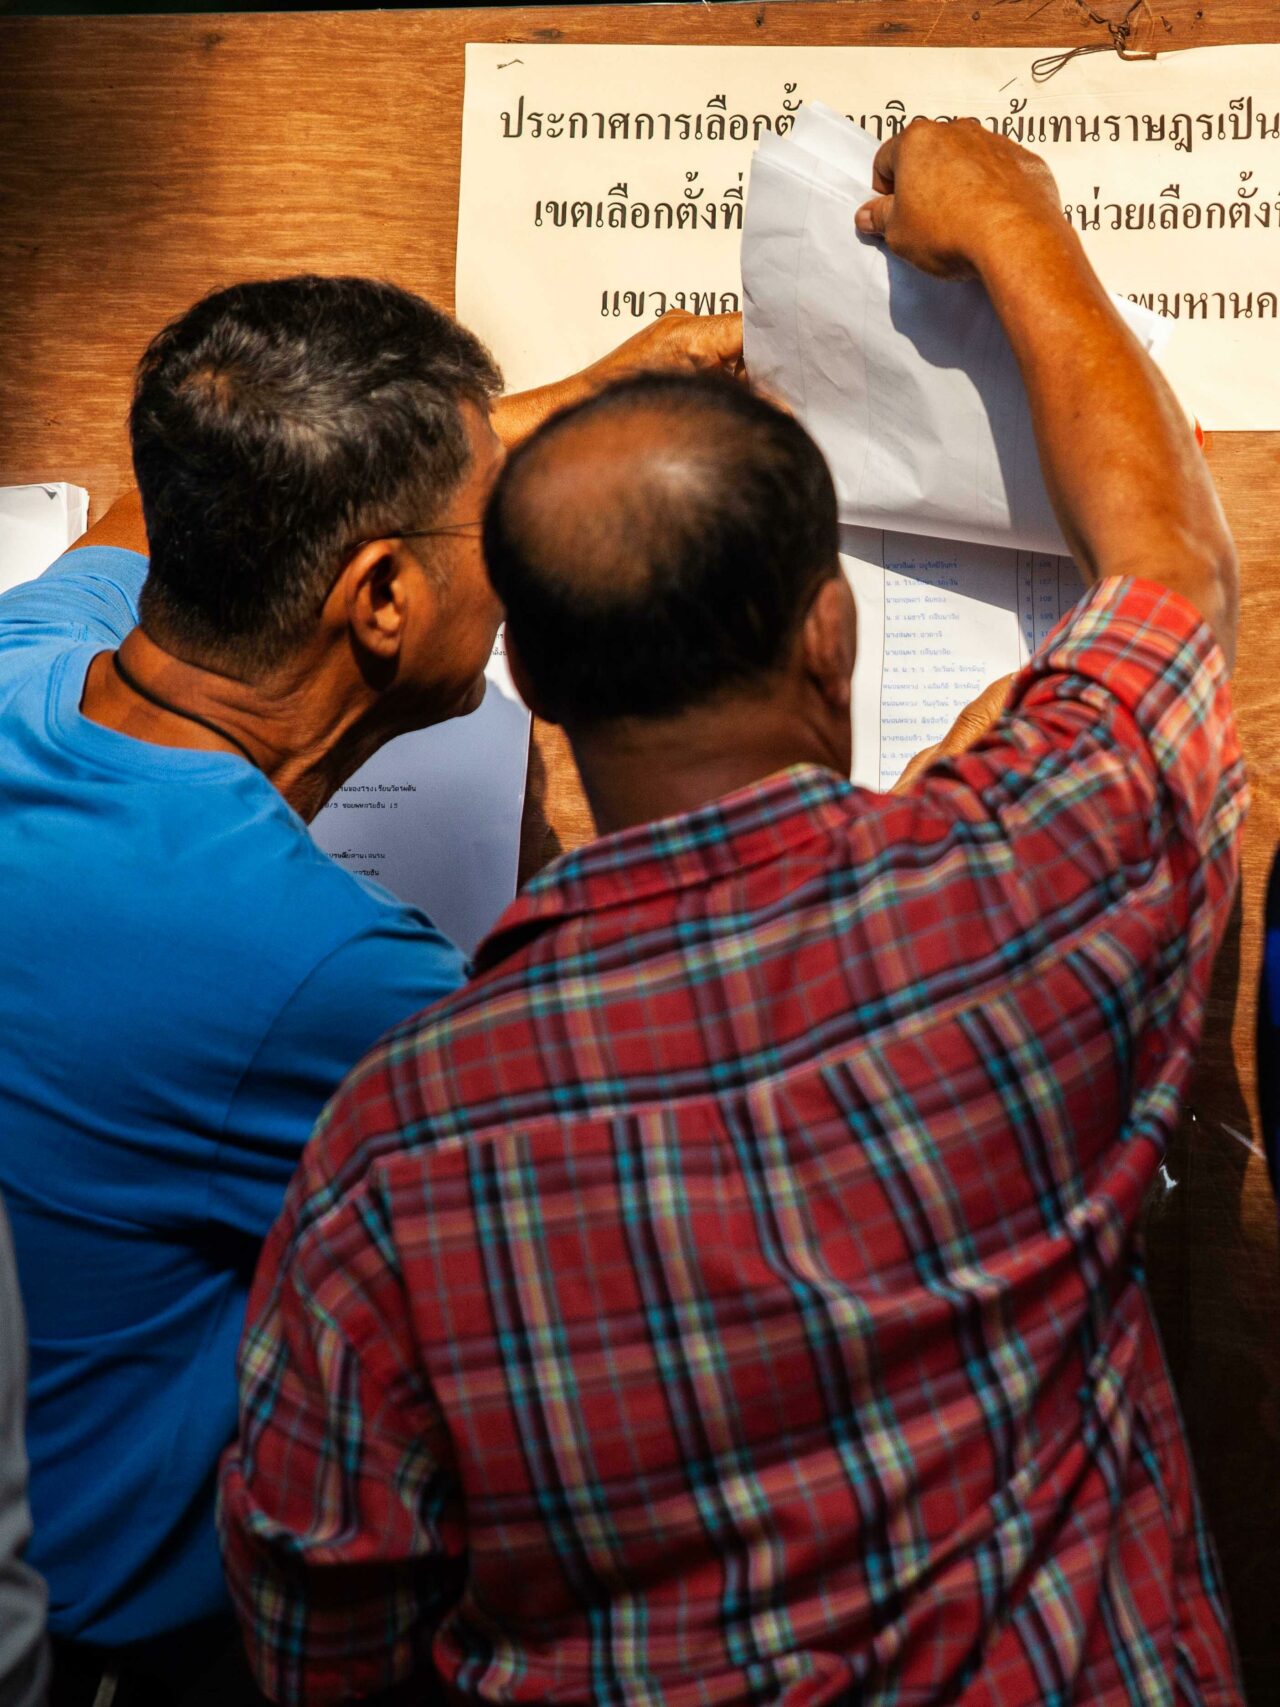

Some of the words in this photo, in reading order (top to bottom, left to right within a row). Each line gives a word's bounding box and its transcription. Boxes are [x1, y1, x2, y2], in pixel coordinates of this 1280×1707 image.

[534, 171, 744, 230] เขตเลือกตั้งที่
